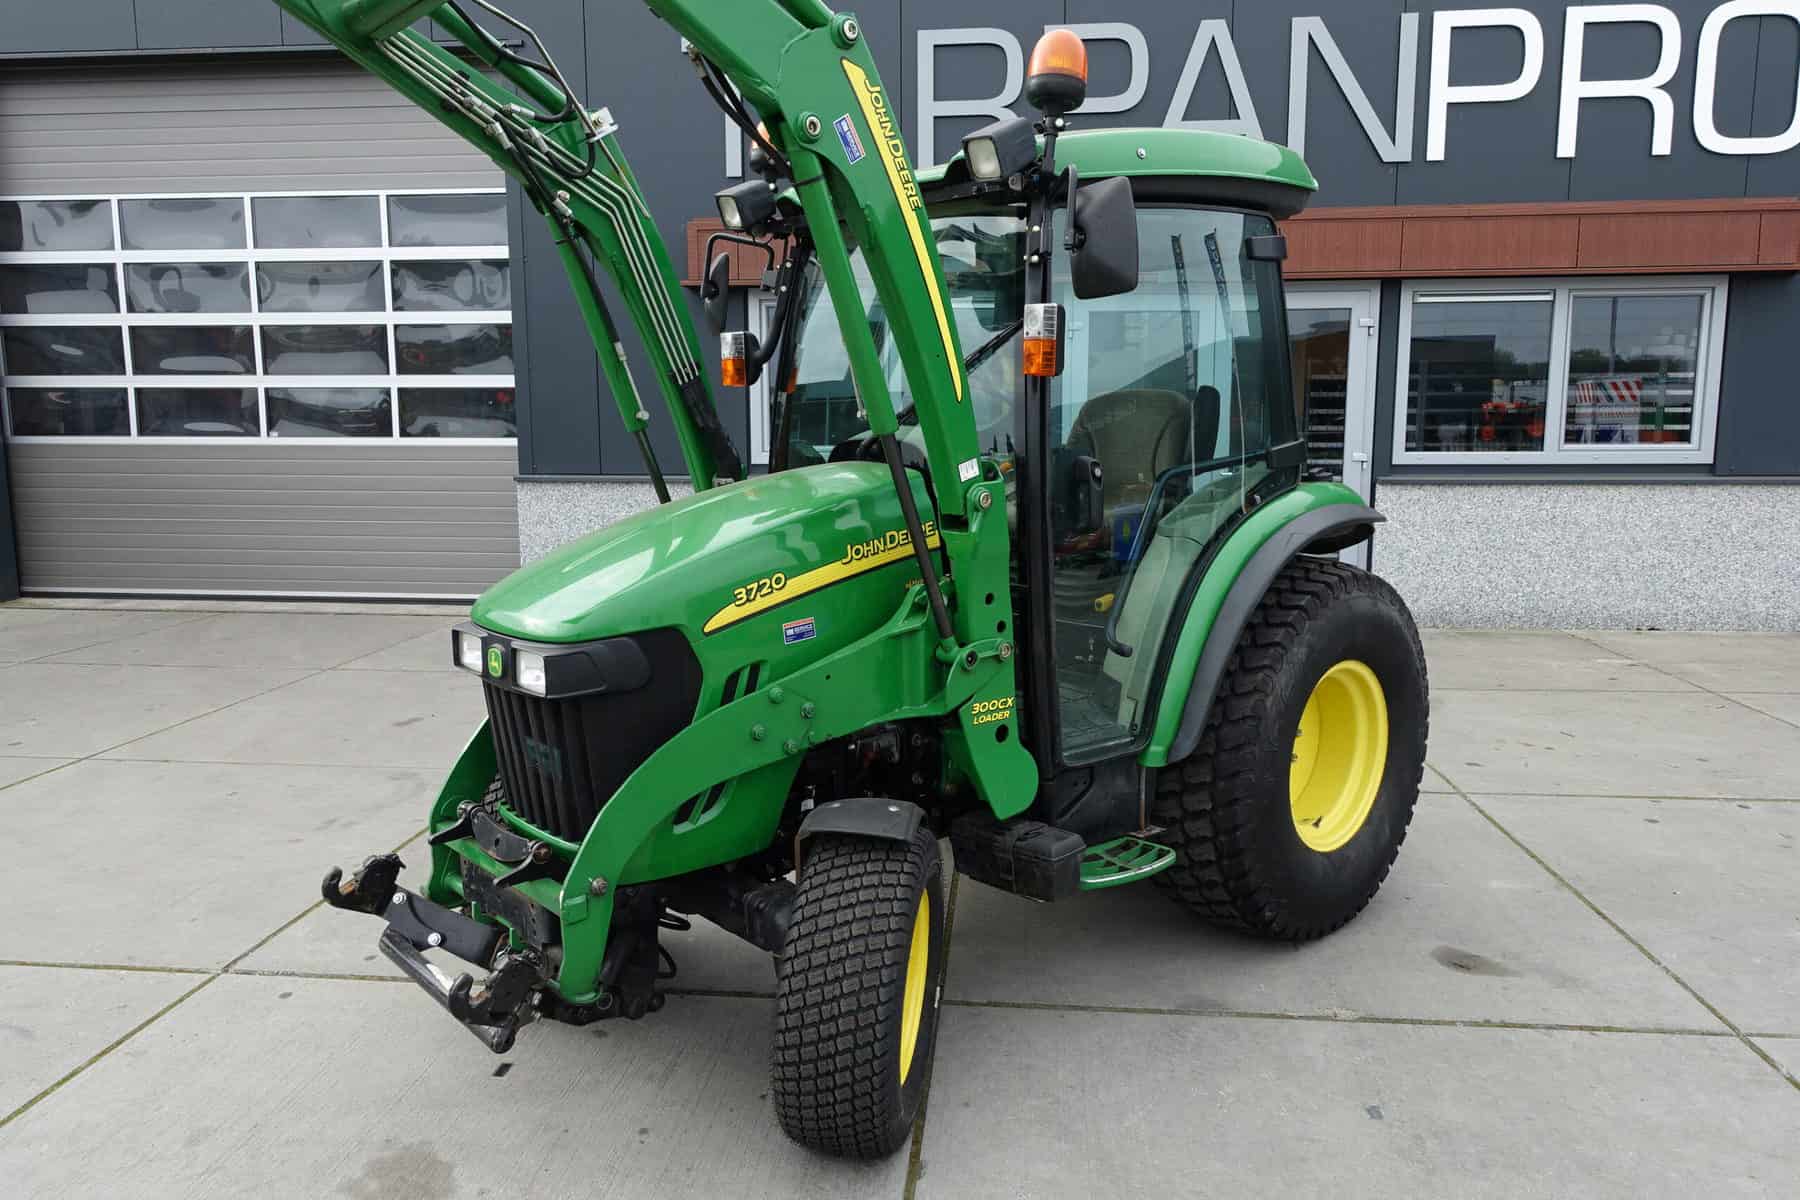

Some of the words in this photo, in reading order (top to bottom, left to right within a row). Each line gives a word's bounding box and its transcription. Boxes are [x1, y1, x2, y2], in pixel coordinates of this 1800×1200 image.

[865, 79, 896, 139] JOHN
[887, 139, 922, 211] DEERE
[841, 535, 885, 565] JOHN
[885, 521, 936, 550] DEE
[733, 571, 786, 606] 3720
[971, 696, 1014, 714] 300CX
[973, 710, 1010, 725] LOADER
